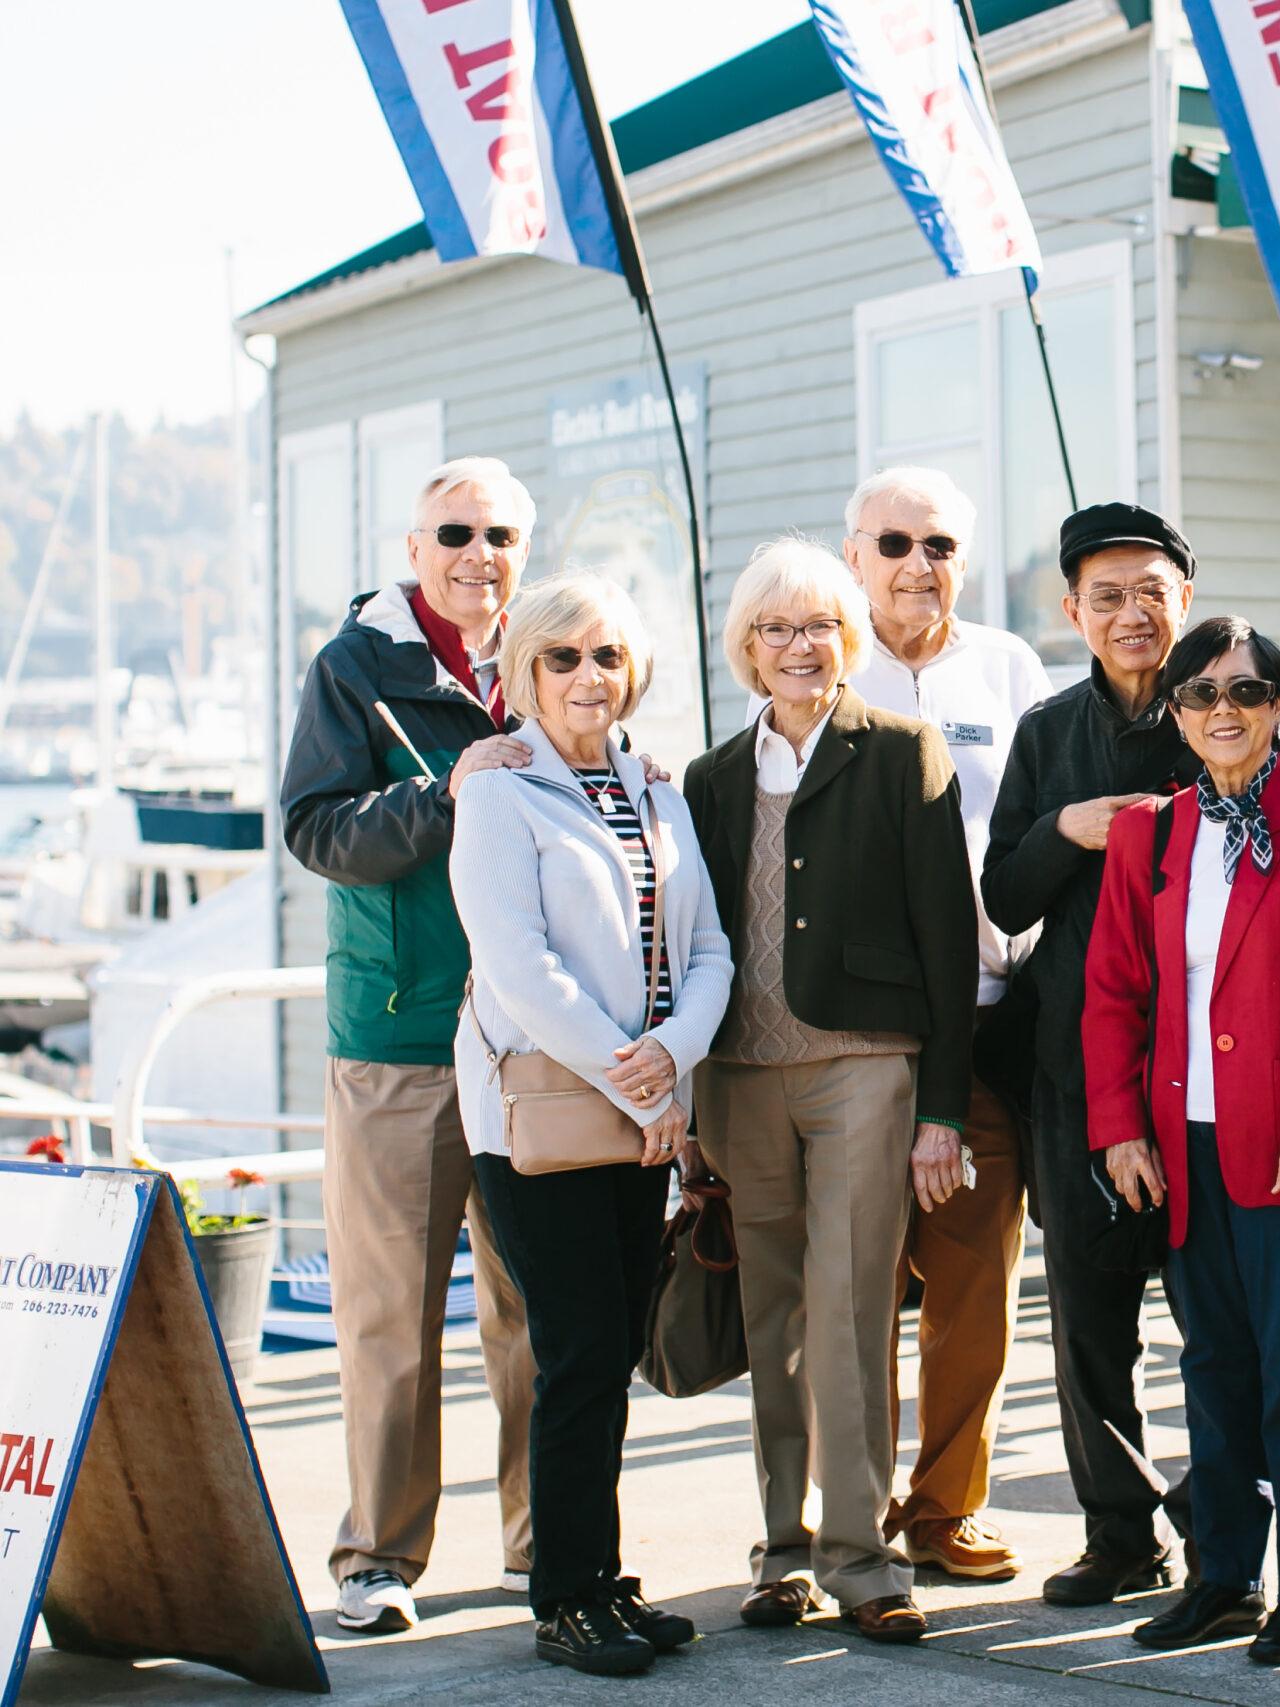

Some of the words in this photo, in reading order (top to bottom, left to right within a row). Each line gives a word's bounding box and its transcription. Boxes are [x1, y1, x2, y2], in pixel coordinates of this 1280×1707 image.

[959, 726, 977, 734] Dick
[955, 732, 982, 742] Parker
[16, 1252, 118, 1297] COMPANY
